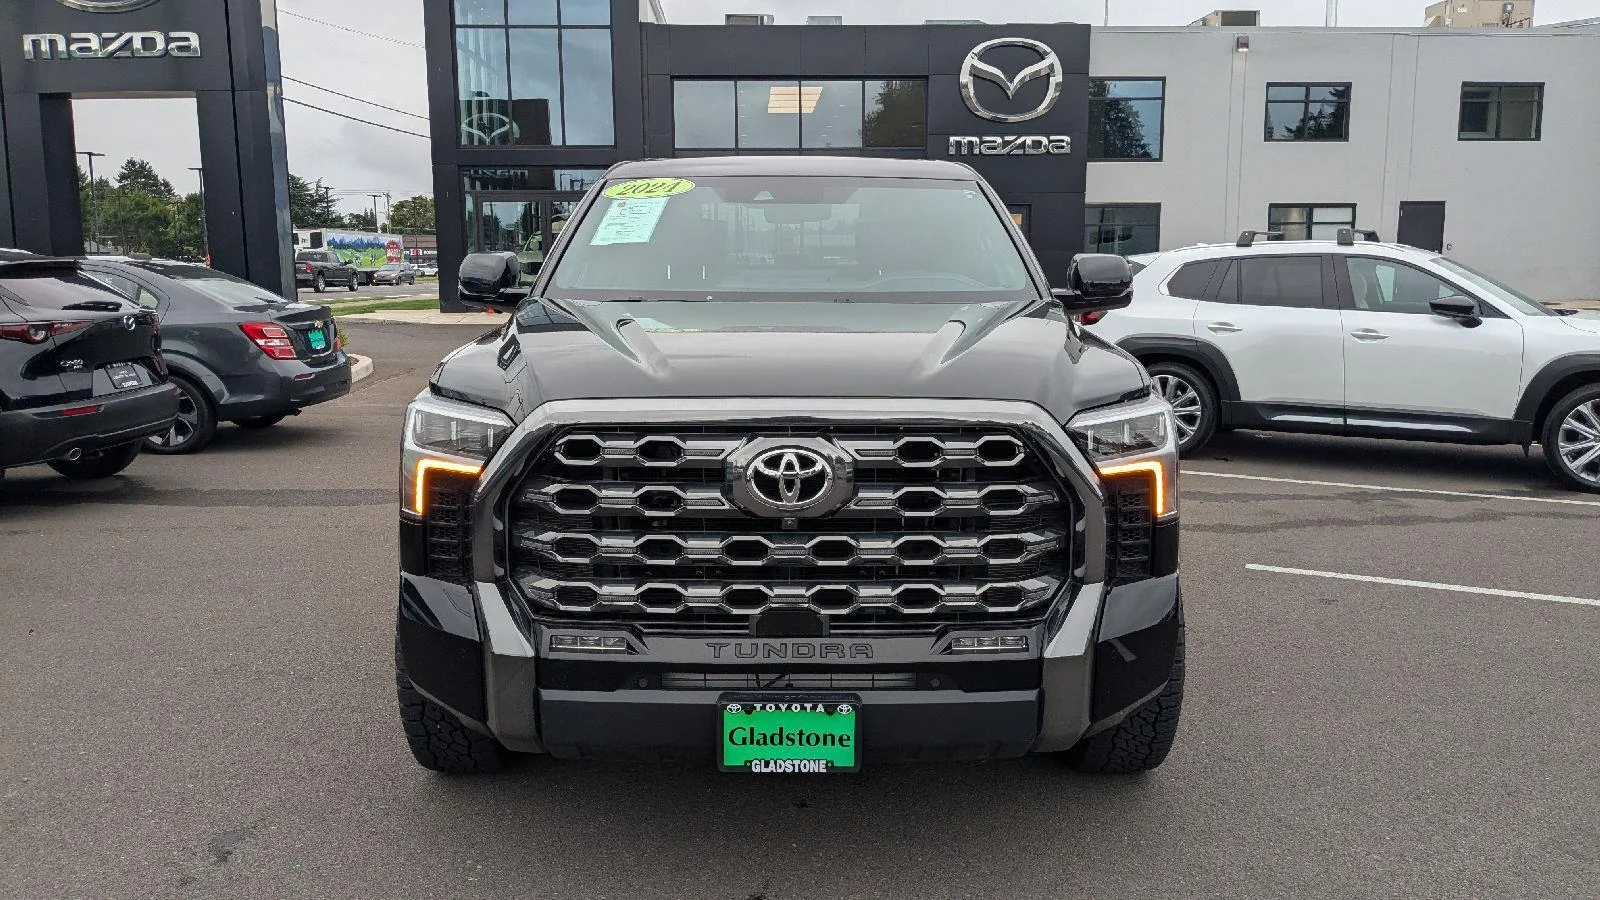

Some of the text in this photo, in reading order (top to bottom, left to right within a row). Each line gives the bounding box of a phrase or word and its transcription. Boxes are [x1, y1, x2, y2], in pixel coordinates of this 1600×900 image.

[705, 642, 874, 659] TUNDRA
[753, 703, 825, 712] TOYOTA
[728, 726, 851, 748] Gladstone
[751, 759, 827, 773] GLADSTONE
